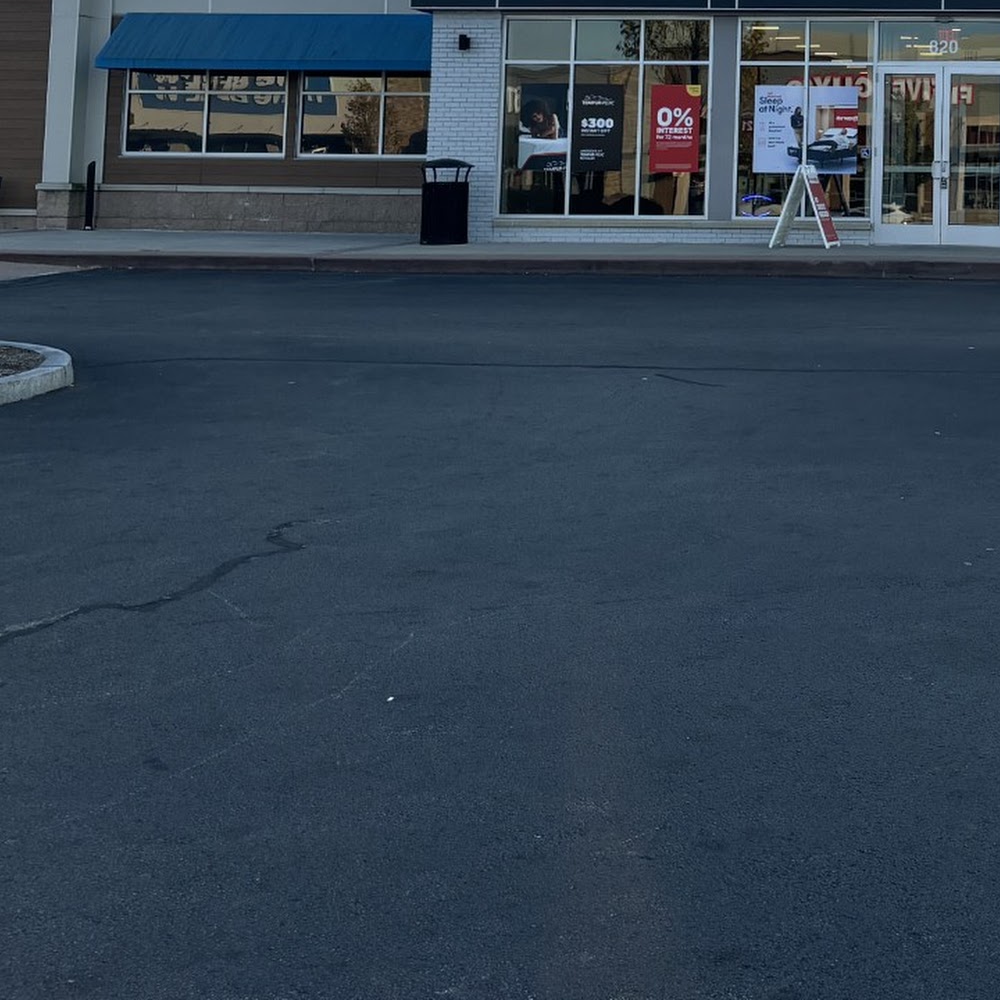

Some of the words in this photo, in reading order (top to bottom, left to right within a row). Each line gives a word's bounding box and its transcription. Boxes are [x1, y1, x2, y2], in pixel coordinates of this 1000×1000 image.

[929, 40, 958, 54] 820
[759, 96, 783, 107] Sleep
[581, 118, 614, 128] $300
[657, 107, 693, 127] 0%
